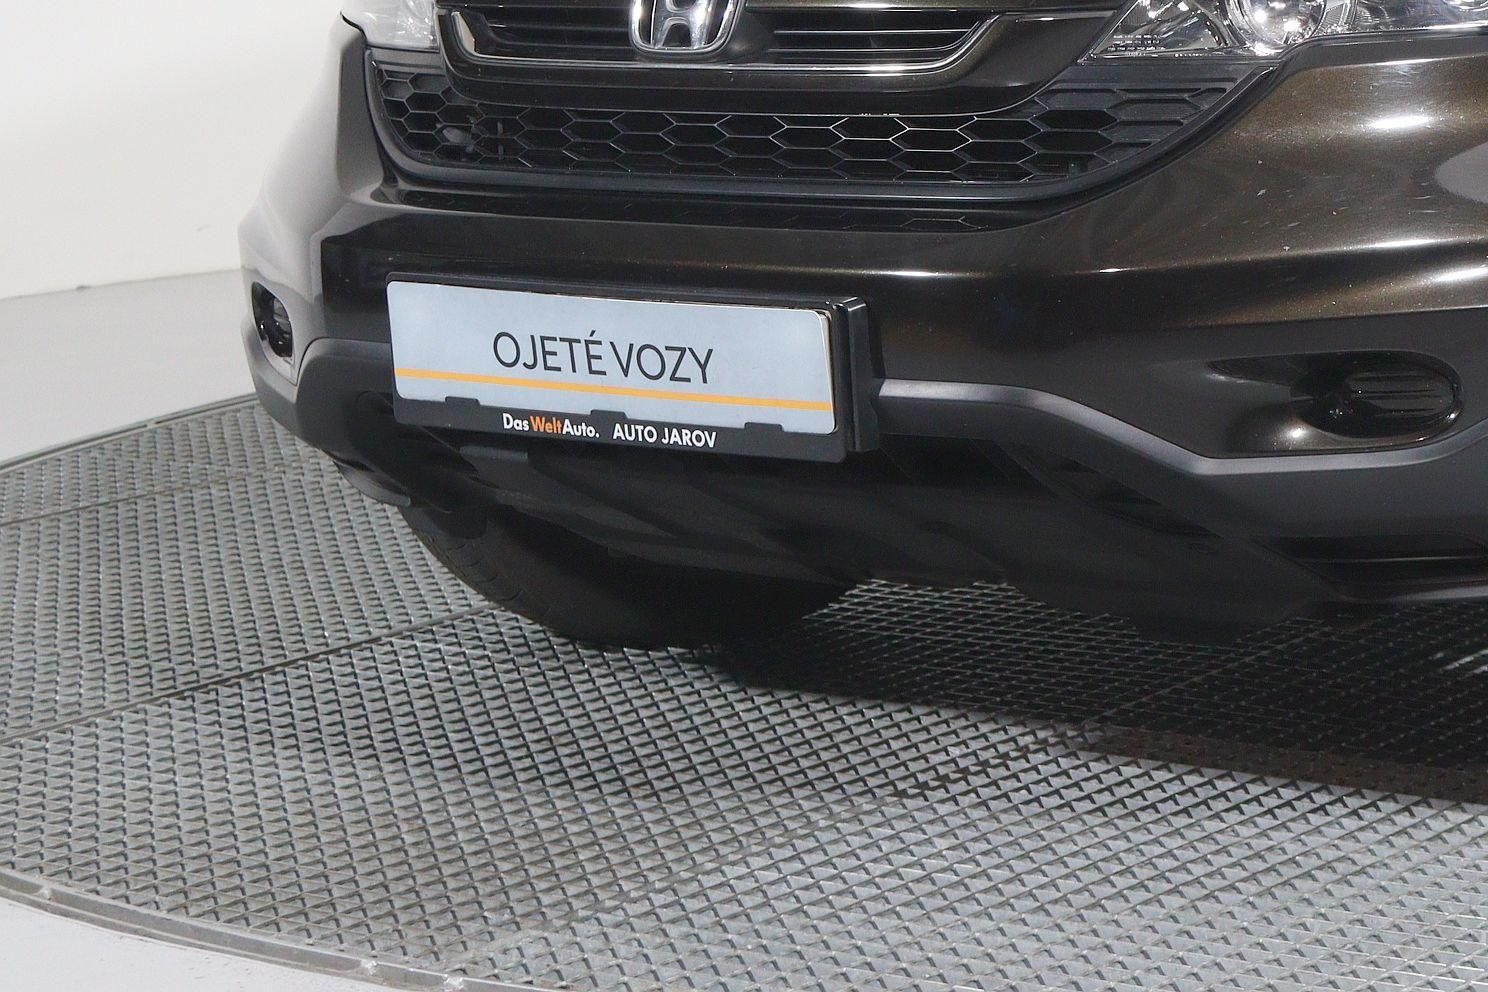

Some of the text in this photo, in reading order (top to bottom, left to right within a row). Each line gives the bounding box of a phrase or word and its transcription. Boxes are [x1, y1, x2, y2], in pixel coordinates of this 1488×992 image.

[492, 329, 714, 384] OJETÉ VOZY
[502, 412, 530, 432] Das
[612, 423, 717, 448] AUTO JAROV
